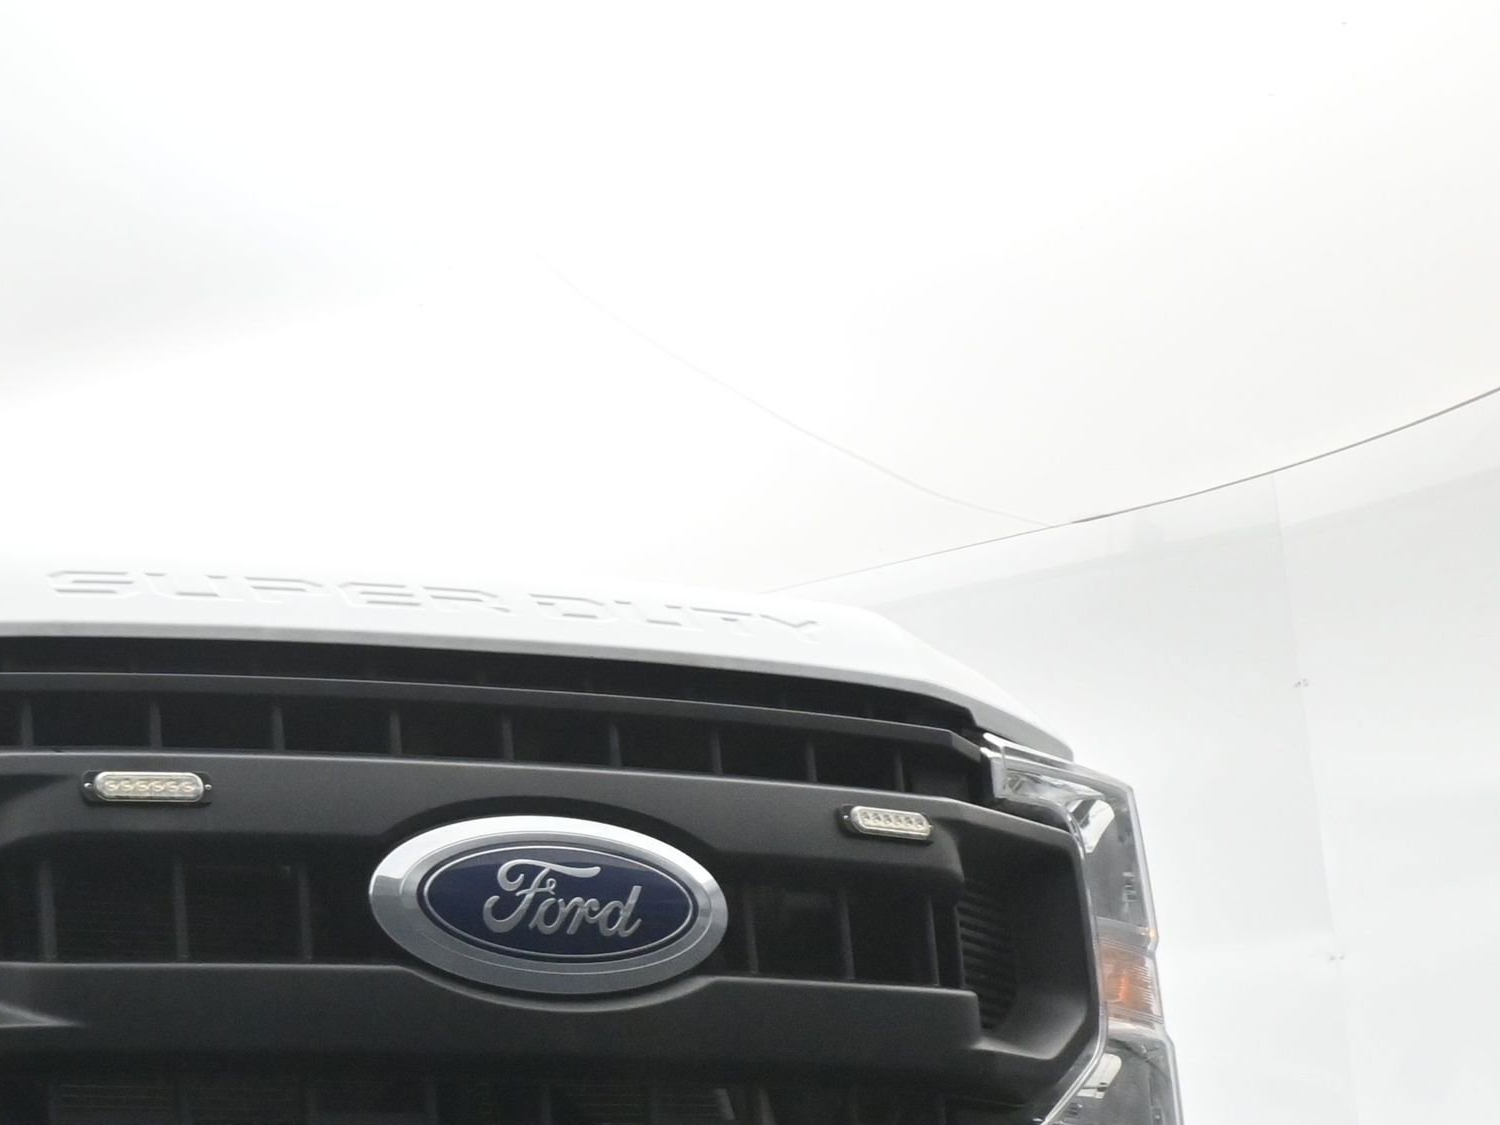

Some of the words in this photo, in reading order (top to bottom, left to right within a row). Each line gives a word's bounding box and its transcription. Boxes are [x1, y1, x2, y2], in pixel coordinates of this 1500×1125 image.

[45, 568, 514, 614] SUPER
[528, 592, 824, 645] DUTY
[483, 858, 643, 938] Ford
